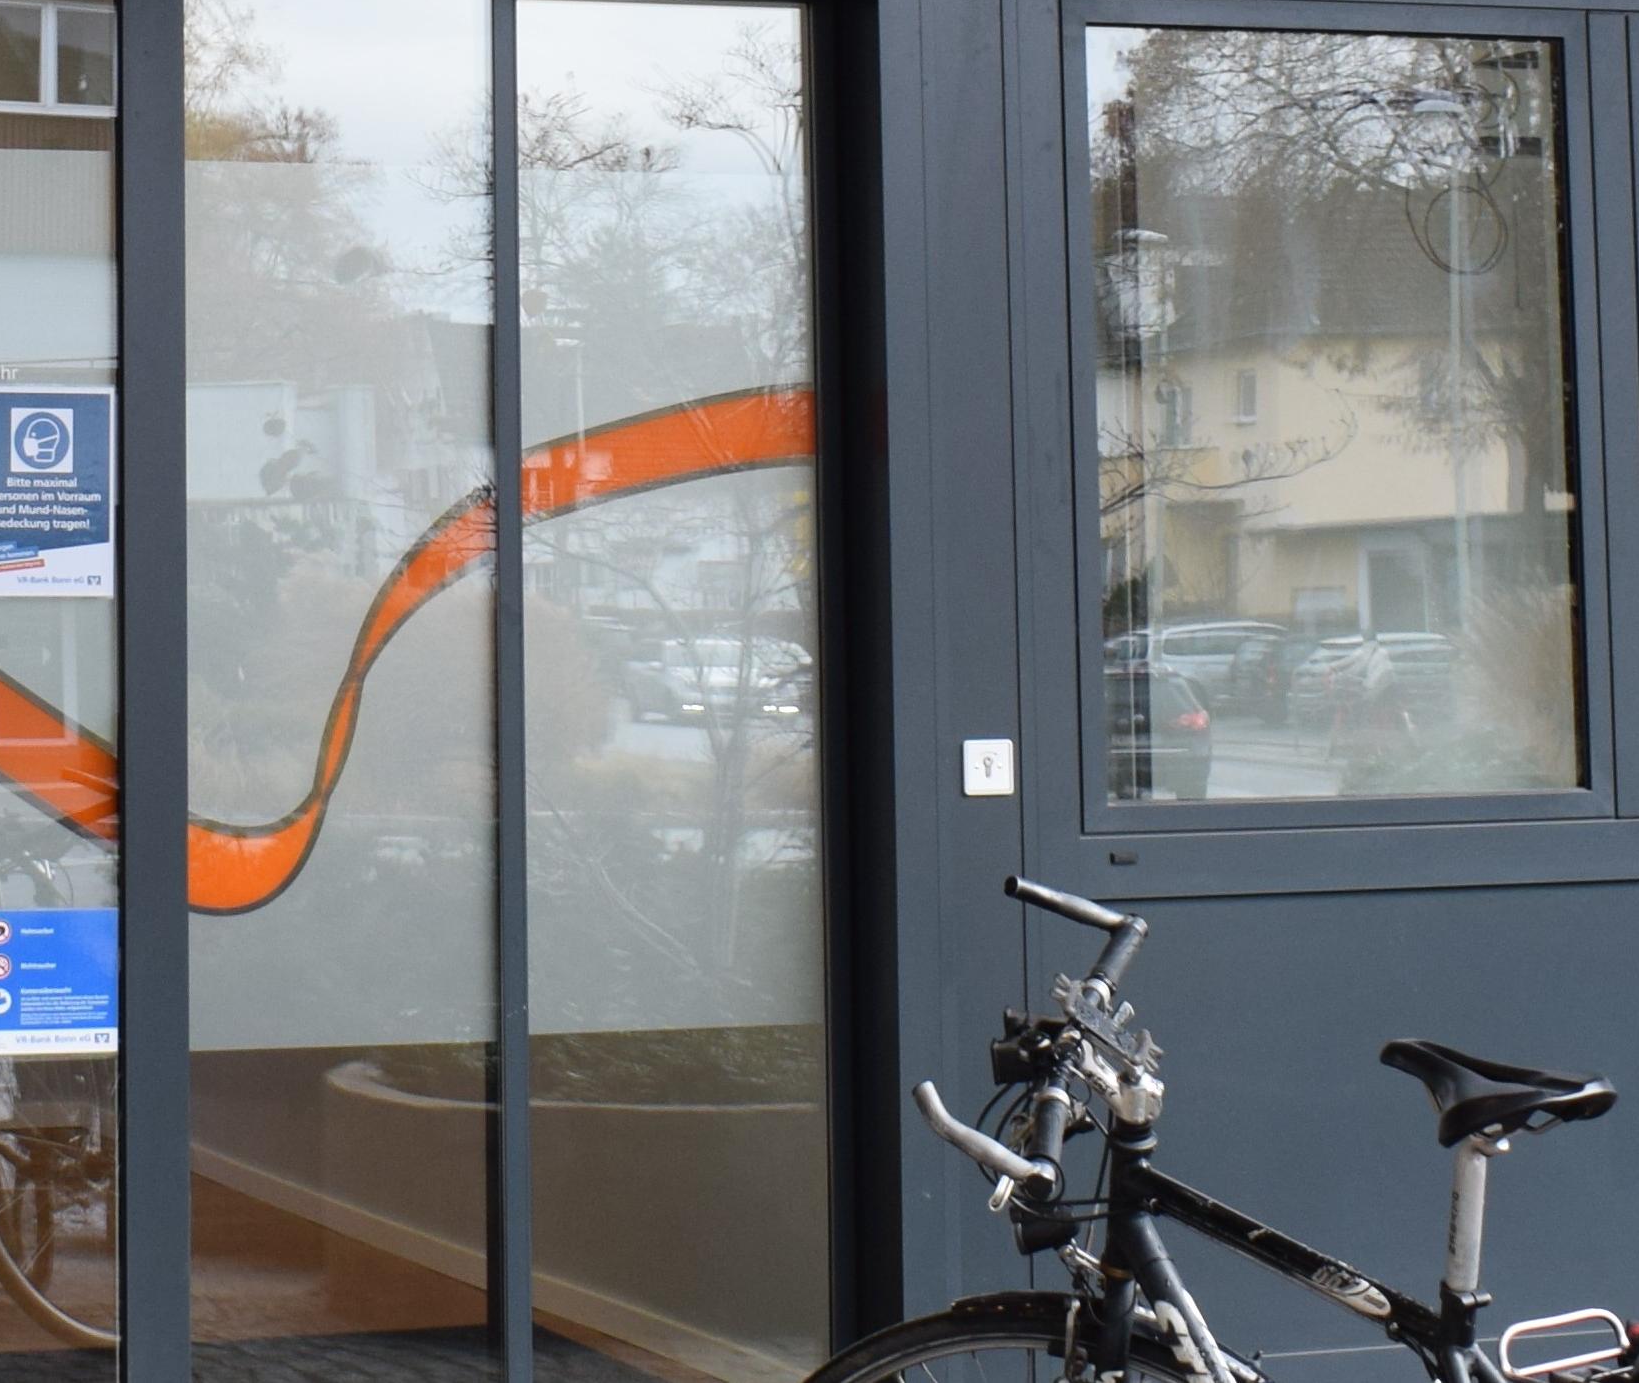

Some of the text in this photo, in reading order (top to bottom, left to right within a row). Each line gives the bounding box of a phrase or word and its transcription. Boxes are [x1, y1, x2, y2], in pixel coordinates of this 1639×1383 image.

[6, 477, 78, 487] Bitte maximal
[41, 491, 55, 501] im
[57, 491, 101, 501] Vorraum
[18, 504, 89, 515] Mund-Nasen-
[53, 519, 90, 531] tragen!
